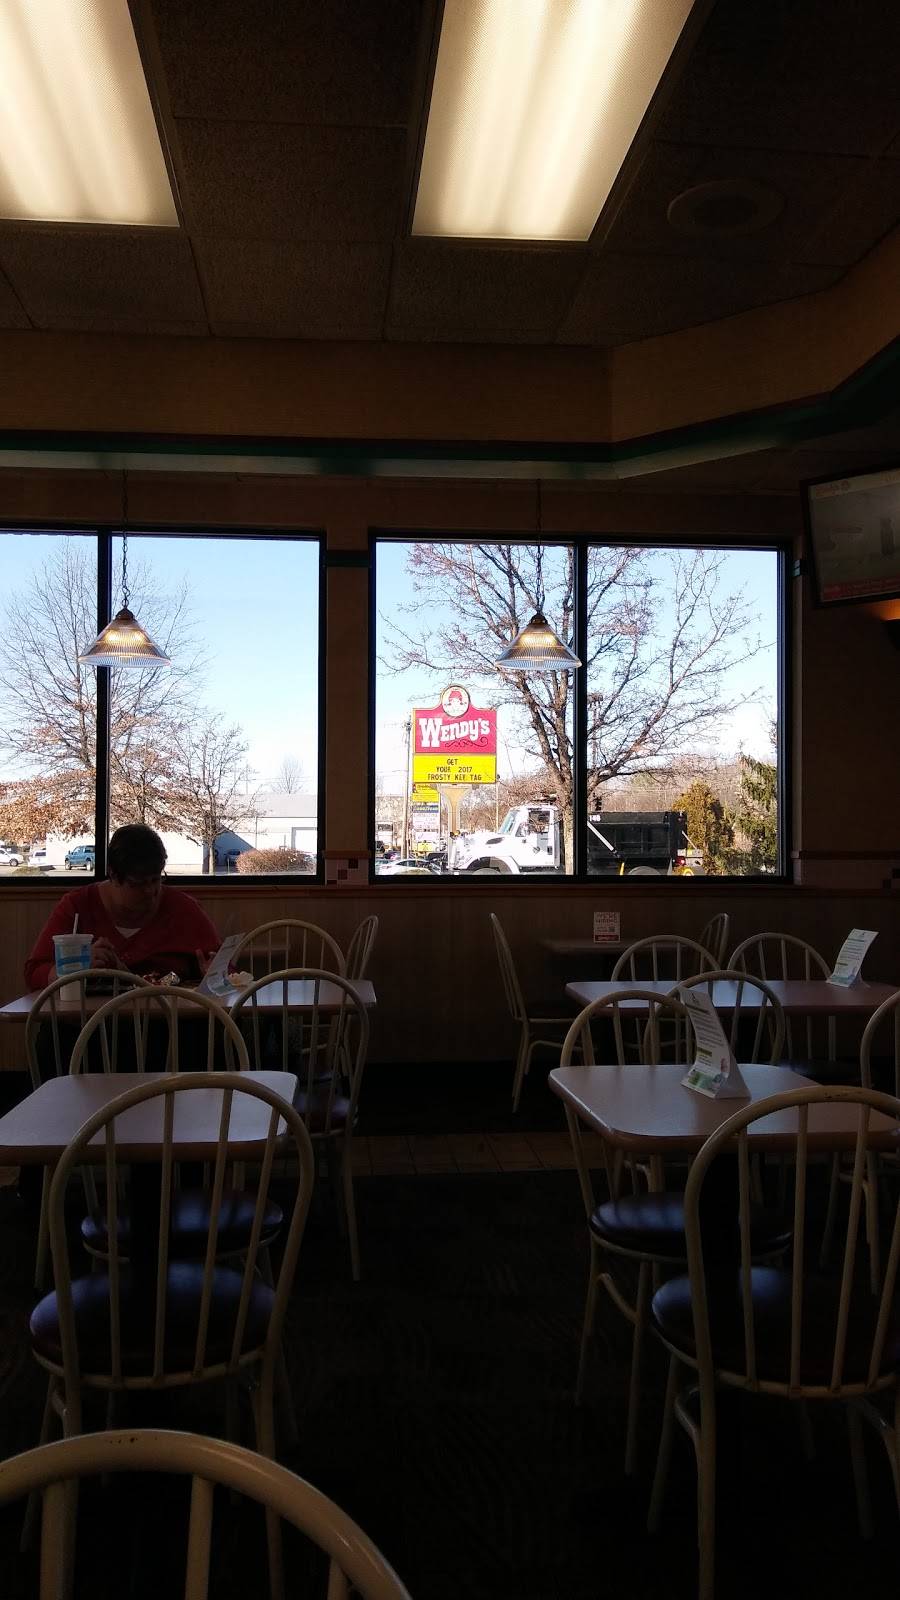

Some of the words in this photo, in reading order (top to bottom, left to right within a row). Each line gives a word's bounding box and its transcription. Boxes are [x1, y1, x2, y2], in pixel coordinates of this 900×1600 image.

[446, 758, 459, 766] GET
[427, 773, 451, 781] FROSTY
[470, 773, 482, 781] TAG
